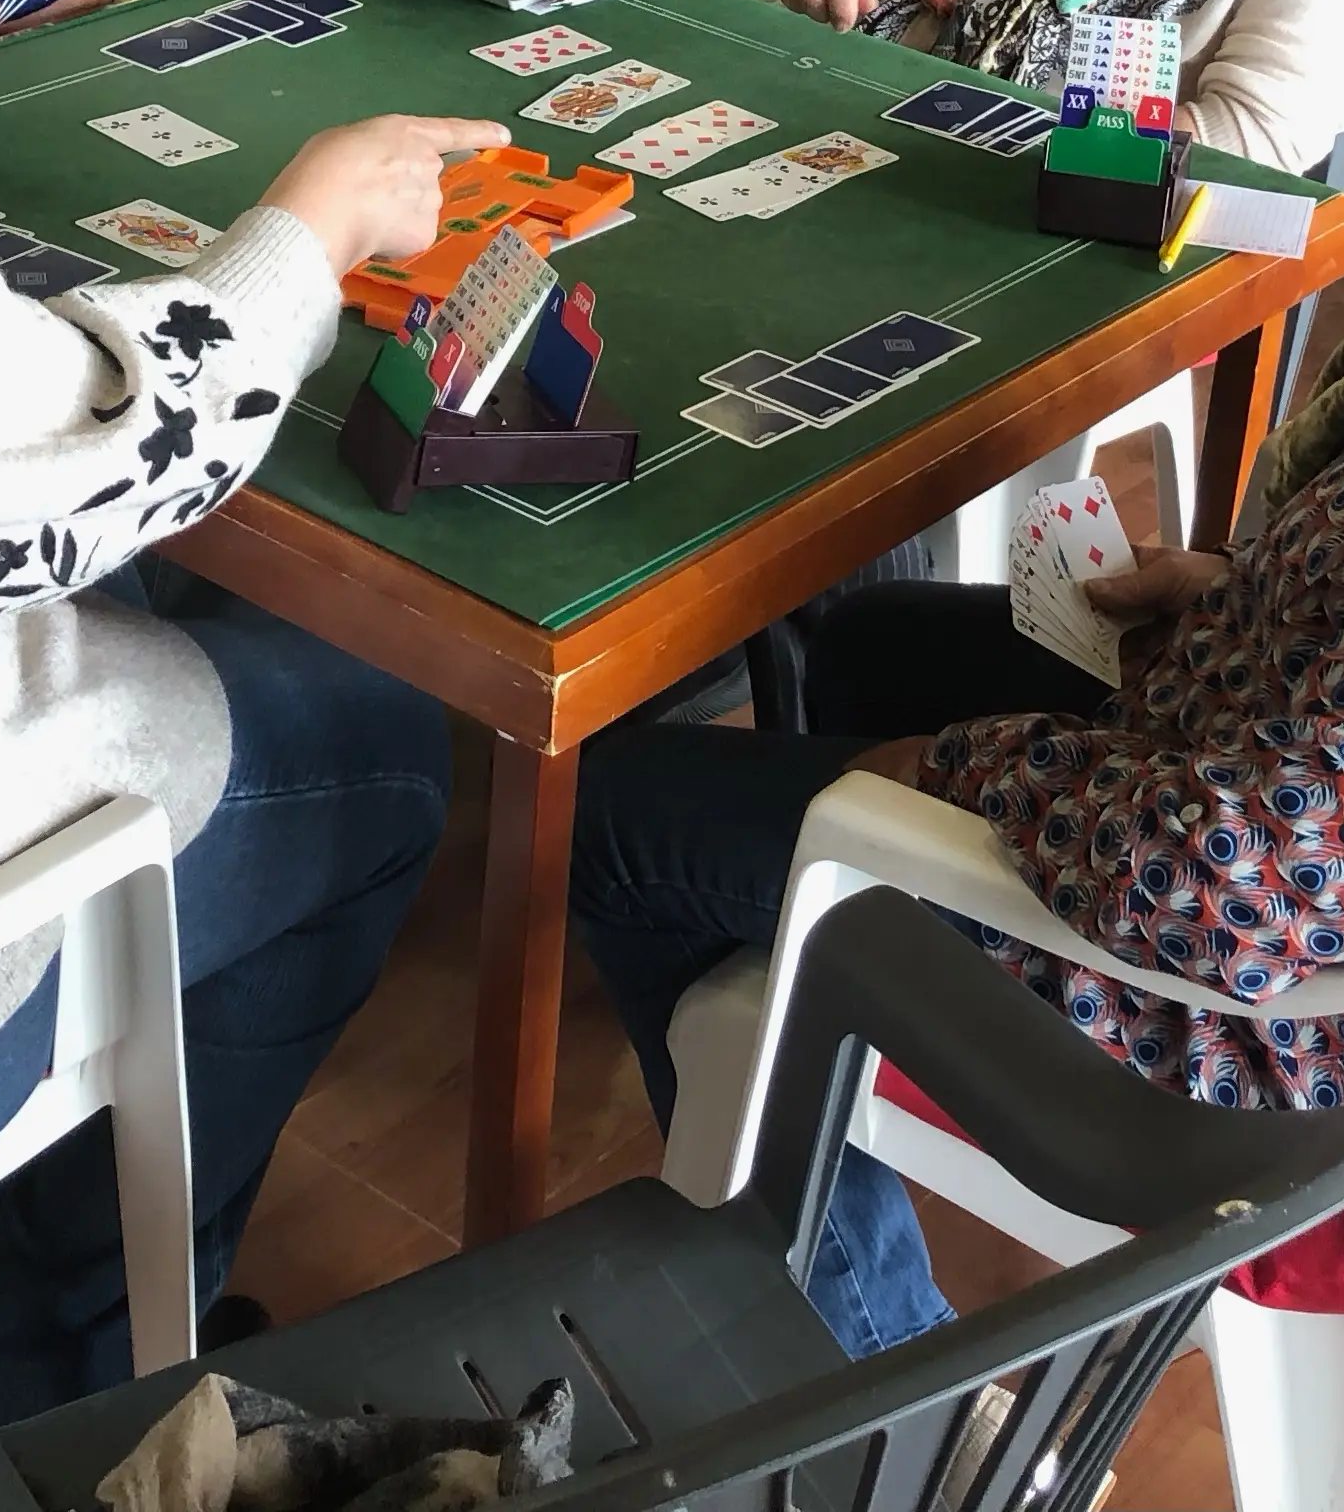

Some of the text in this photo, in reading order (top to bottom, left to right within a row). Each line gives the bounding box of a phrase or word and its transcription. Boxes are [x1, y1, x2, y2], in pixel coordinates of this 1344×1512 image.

[1067, 93, 1088, 110] XX
[1149, 104, 1162, 120] X
[1097, 114, 1125, 129] PASS
[573, 291, 591, 315] STOP
[411, 302, 427, 326] XX
[412, 336, 430, 361] PASS
[443, 343, 456, 363] X
[1094, 481, 1104, 495] 5
